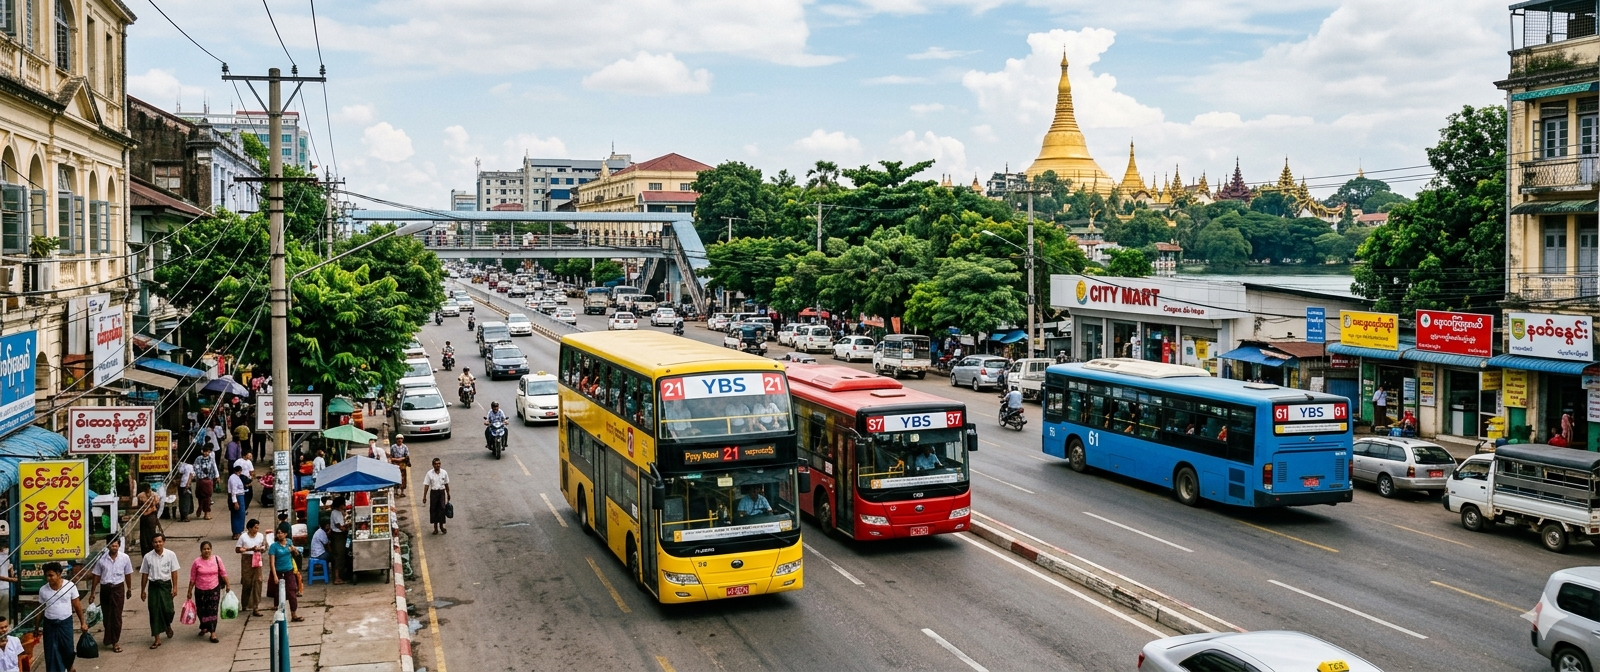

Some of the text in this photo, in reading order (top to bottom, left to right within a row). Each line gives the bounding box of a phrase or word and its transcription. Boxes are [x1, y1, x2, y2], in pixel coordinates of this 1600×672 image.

[1090, 285, 1160, 307] CITY MART
[663, 377, 782, 397] 21 YBS 21
[900, 415, 931, 428] YBS
[947, 413, 961, 425] 37
[1275, 408, 1287, 419] 61
[1300, 406, 1324, 418] YBS
[1088, 430, 1099, 447] 61
[723, 446, 739, 460] 21
